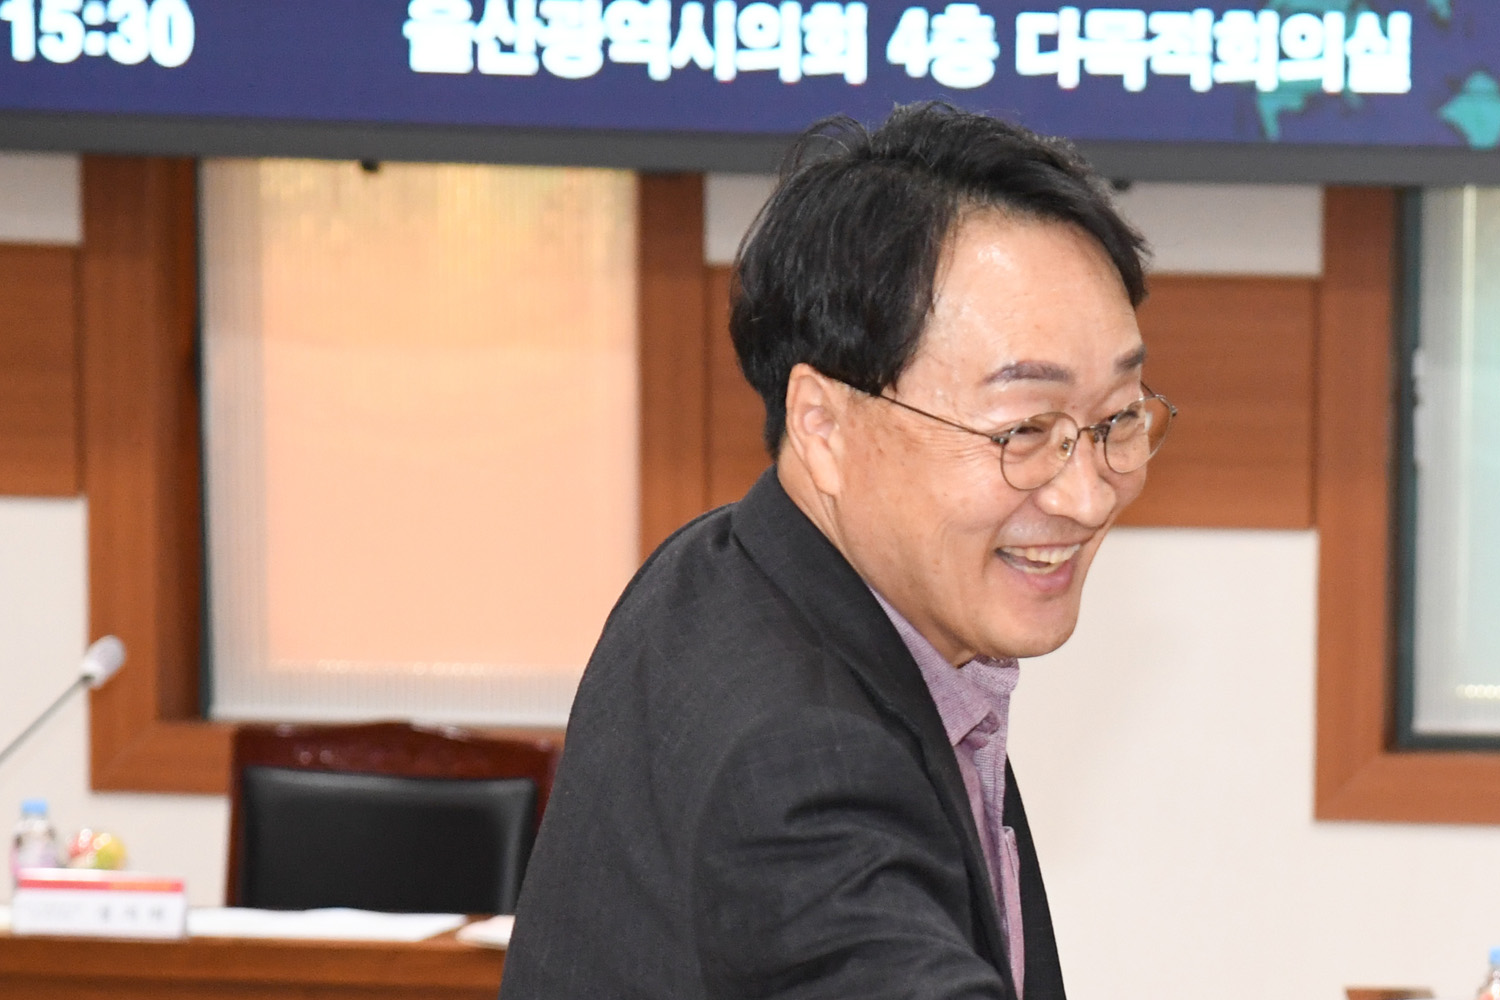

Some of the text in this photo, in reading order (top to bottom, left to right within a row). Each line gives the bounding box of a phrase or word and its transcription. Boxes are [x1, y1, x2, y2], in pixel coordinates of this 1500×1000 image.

[0, 0, 196, 68] 15:30
[402, 0, 1412, 93] 울산광역시의회 4층 다목적회의실
